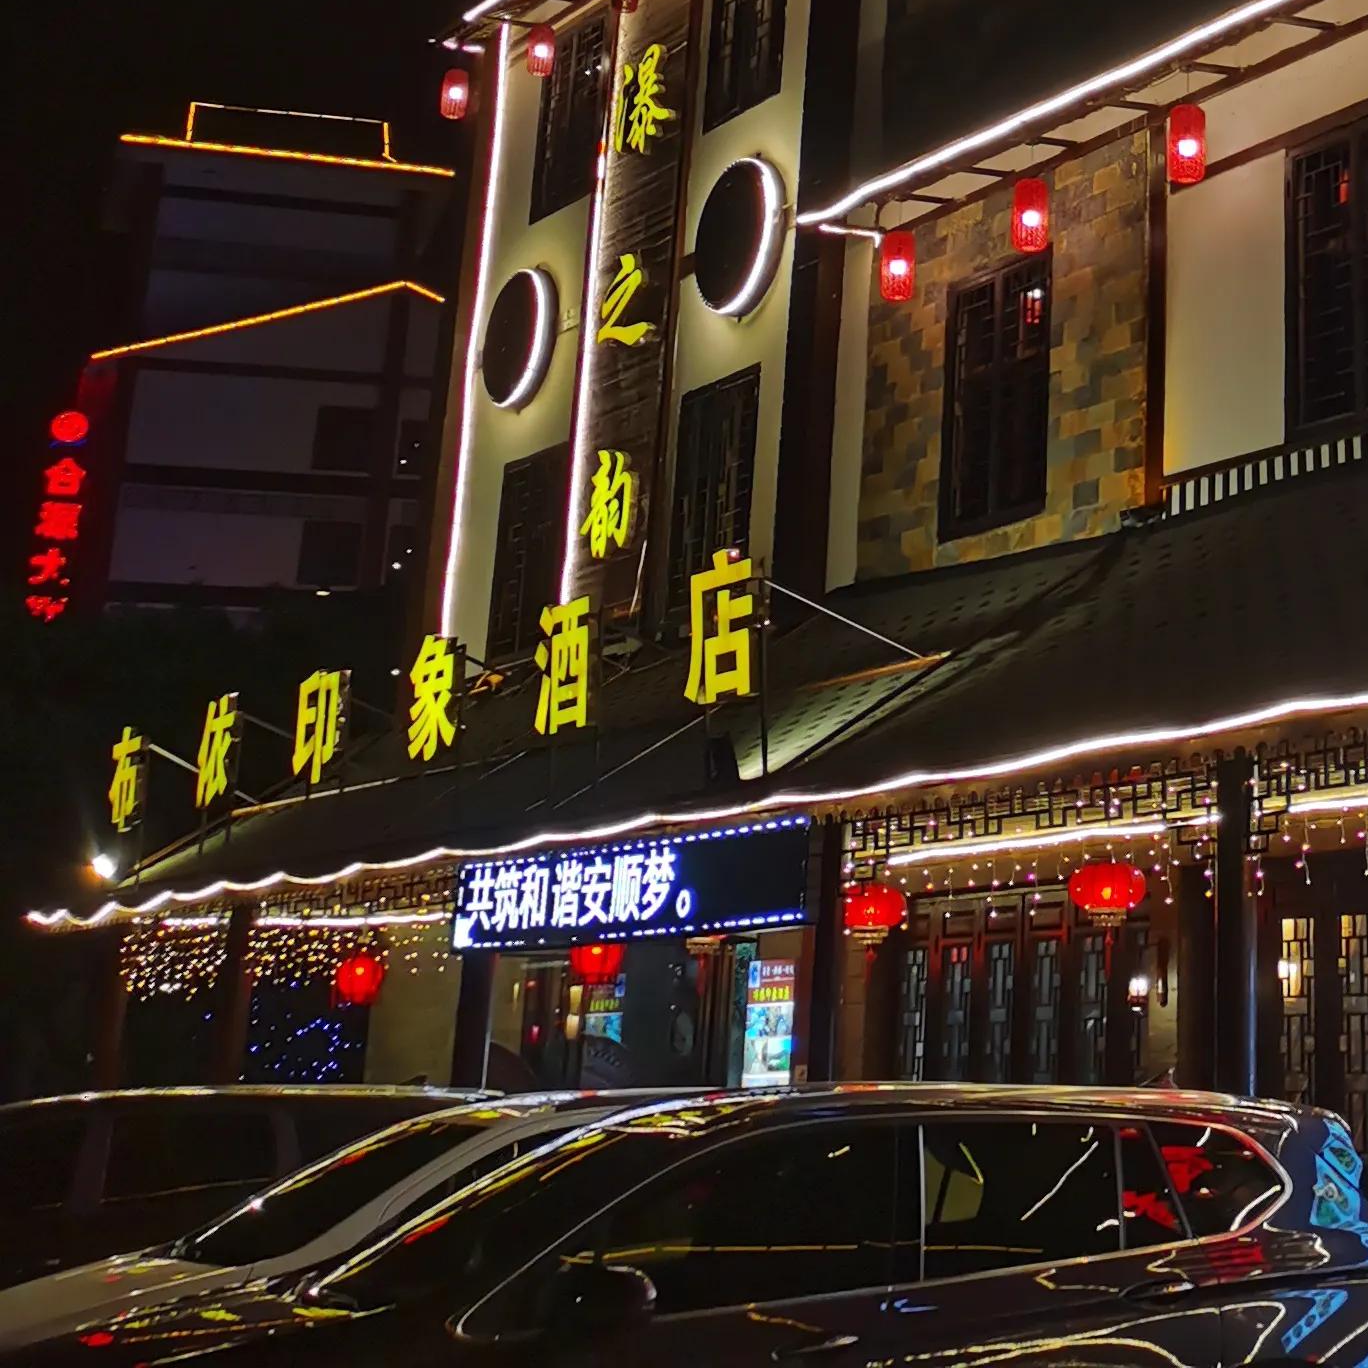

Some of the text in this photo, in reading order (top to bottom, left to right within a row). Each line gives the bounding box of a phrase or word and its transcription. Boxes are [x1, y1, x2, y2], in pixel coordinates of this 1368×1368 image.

[579, 43, 675, 559] 瀑之韵
[108, 548, 753, 833] 布依印象酒店
[464, 845, 692, 933] 共筑和谐安顺梦。
